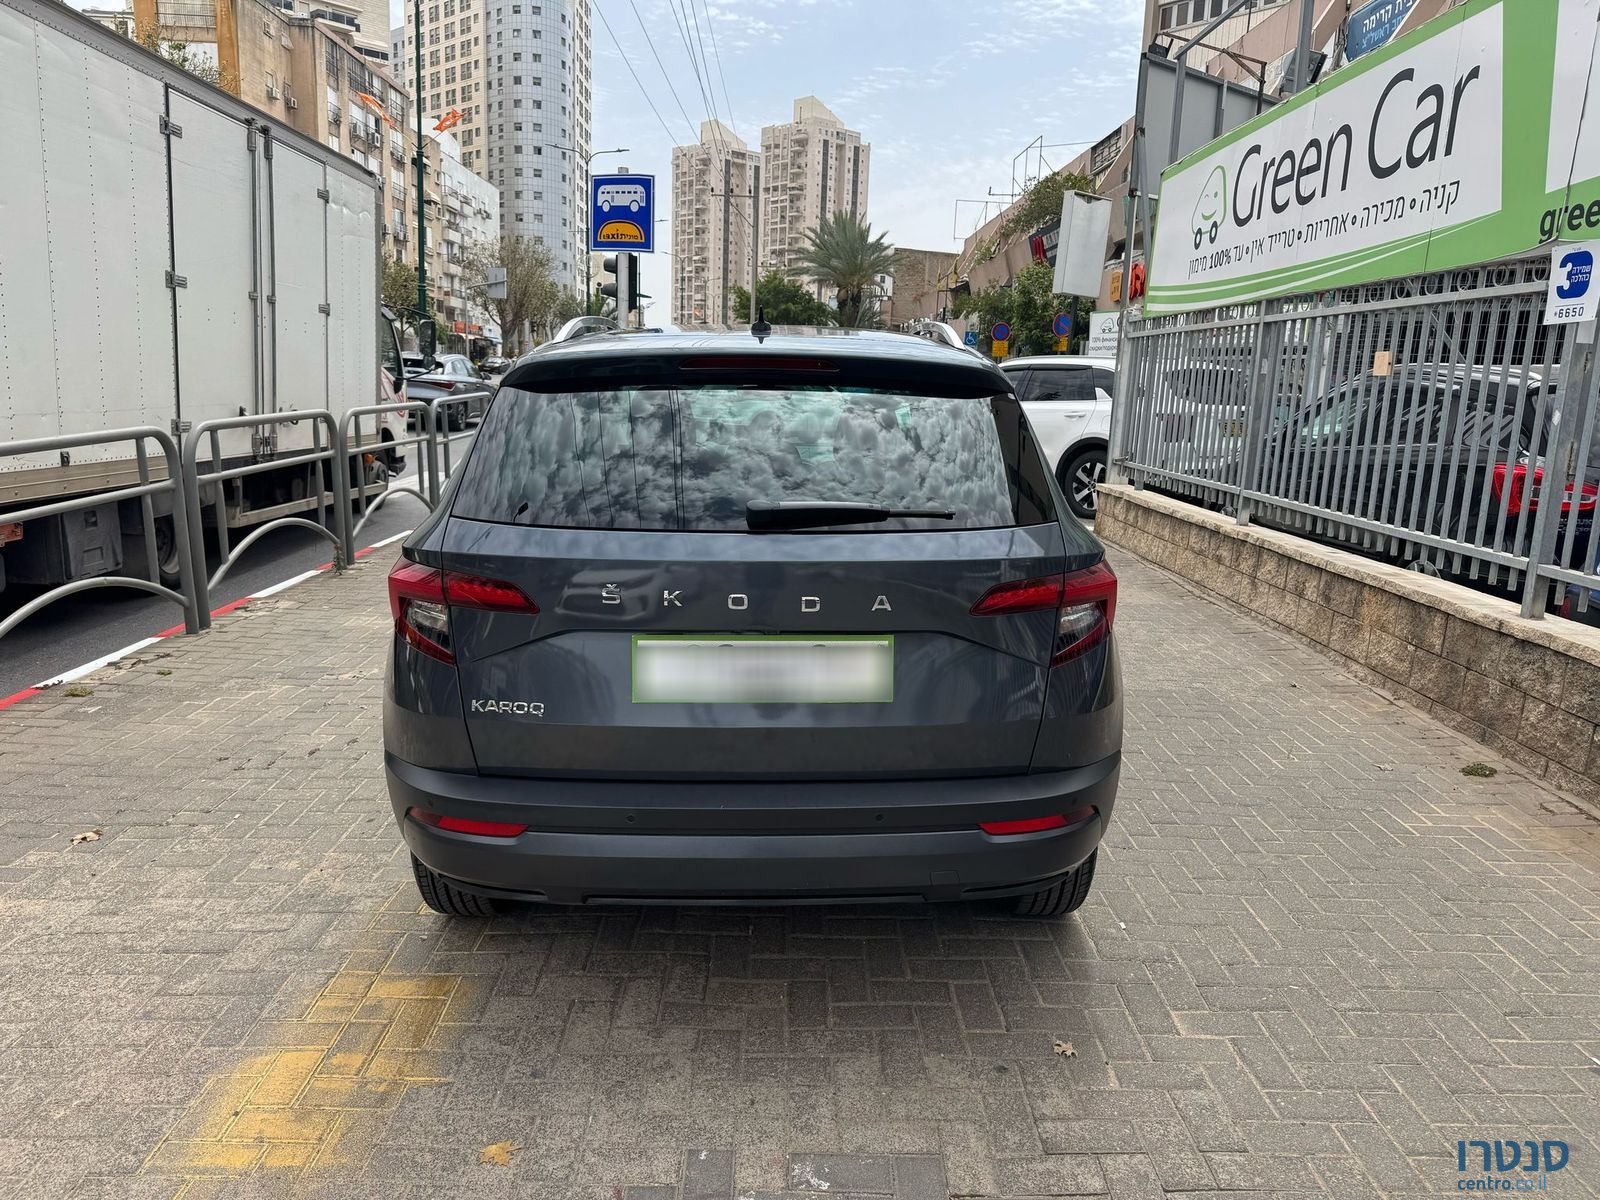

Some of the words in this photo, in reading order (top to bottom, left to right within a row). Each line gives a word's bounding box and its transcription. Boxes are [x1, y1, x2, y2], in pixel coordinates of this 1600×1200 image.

[1363, 4, 1392, 33] קדימה
[1232, 124, 1353, 228] Green
[1368, 65, 1480, 180] Car
[1419, 180, 1460, 214] קניה
[1360, 196, 1405, 228] מכירה
[1268, 228, 1295, 252] טרייד
[1304, 212, 1349, 243] אחריות
[1209, 248, 1231, 270] 100%
[1233, 244, 1244, 262] עד
[1250, 237, 1265, 263] אין
[1188, 256, 1207, 280] מימון
[1572, 264, 1591, 274] שמירה
[601, 583, 892, 613] ŠKODA
[471, 699, 545, 717] KAROQ
